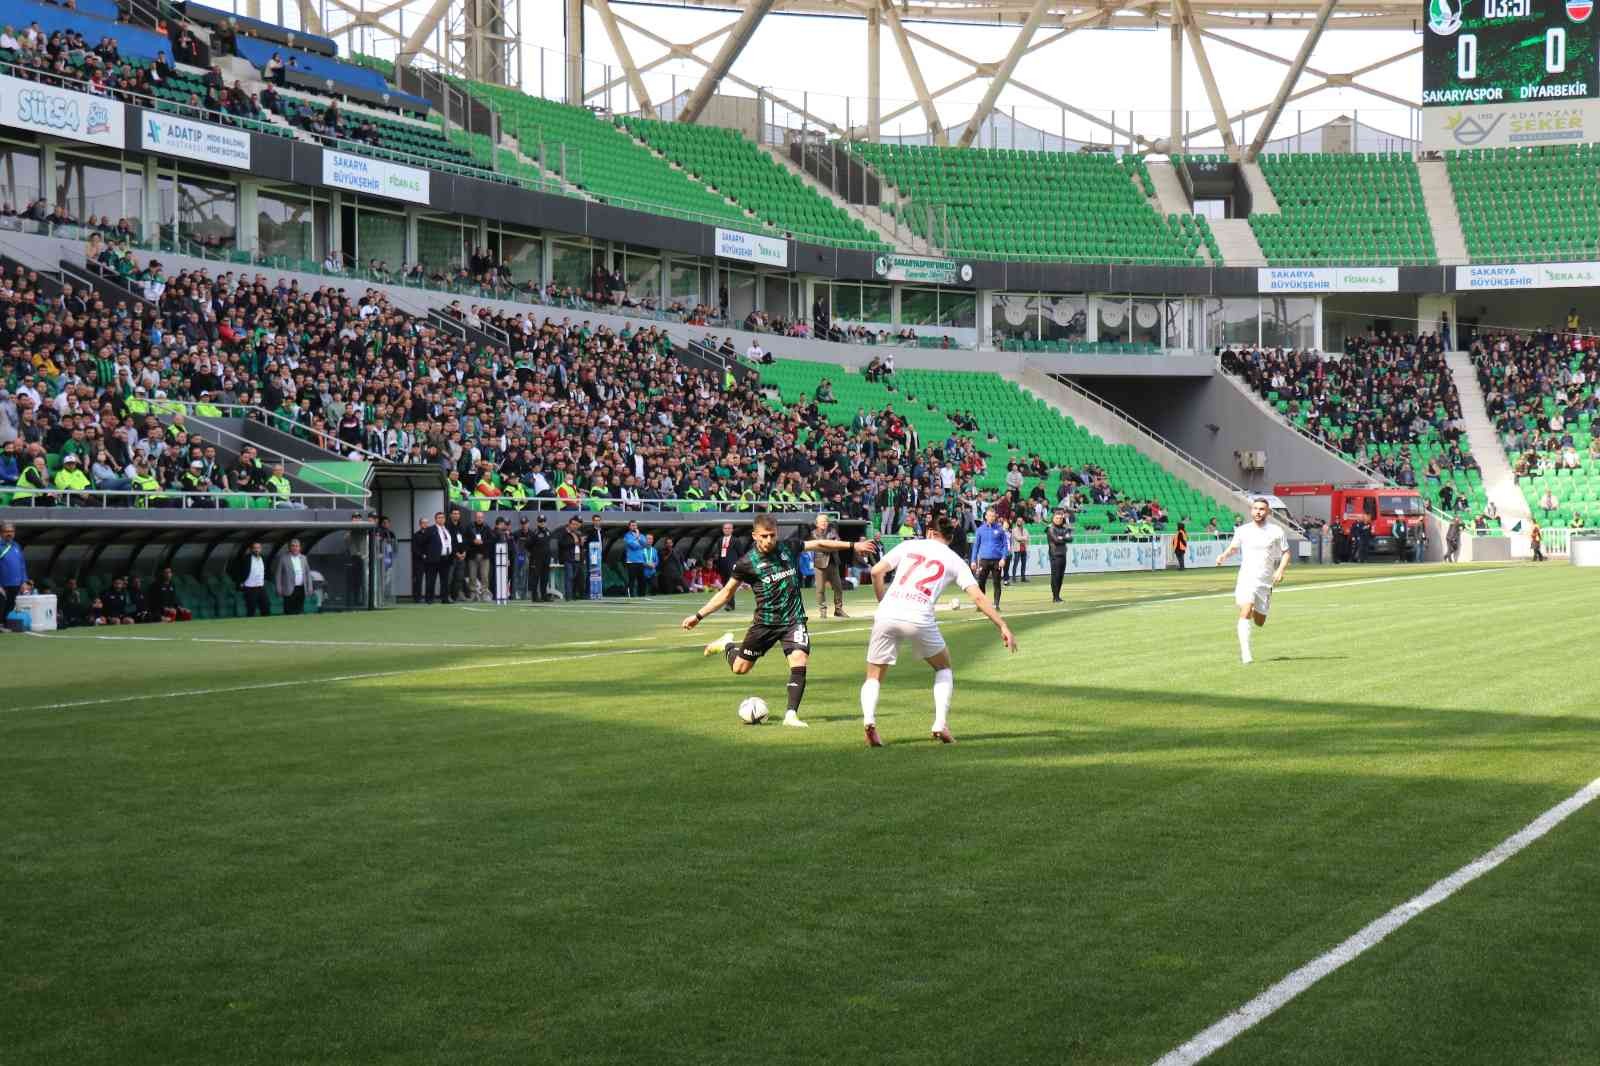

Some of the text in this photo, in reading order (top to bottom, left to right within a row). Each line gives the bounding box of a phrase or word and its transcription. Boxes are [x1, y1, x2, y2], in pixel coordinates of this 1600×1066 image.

[1458, 34, 1477, 79] 0
[1546, 27, 1566, 73] 0
[1423, 88, 1503, 102] SAKARYASPOR
[1520, 81, 1587, 98] DİYARBEKİR
[1471, 268, 1516, 276] SAKARYA
[899, 552, 945, 597] 72
